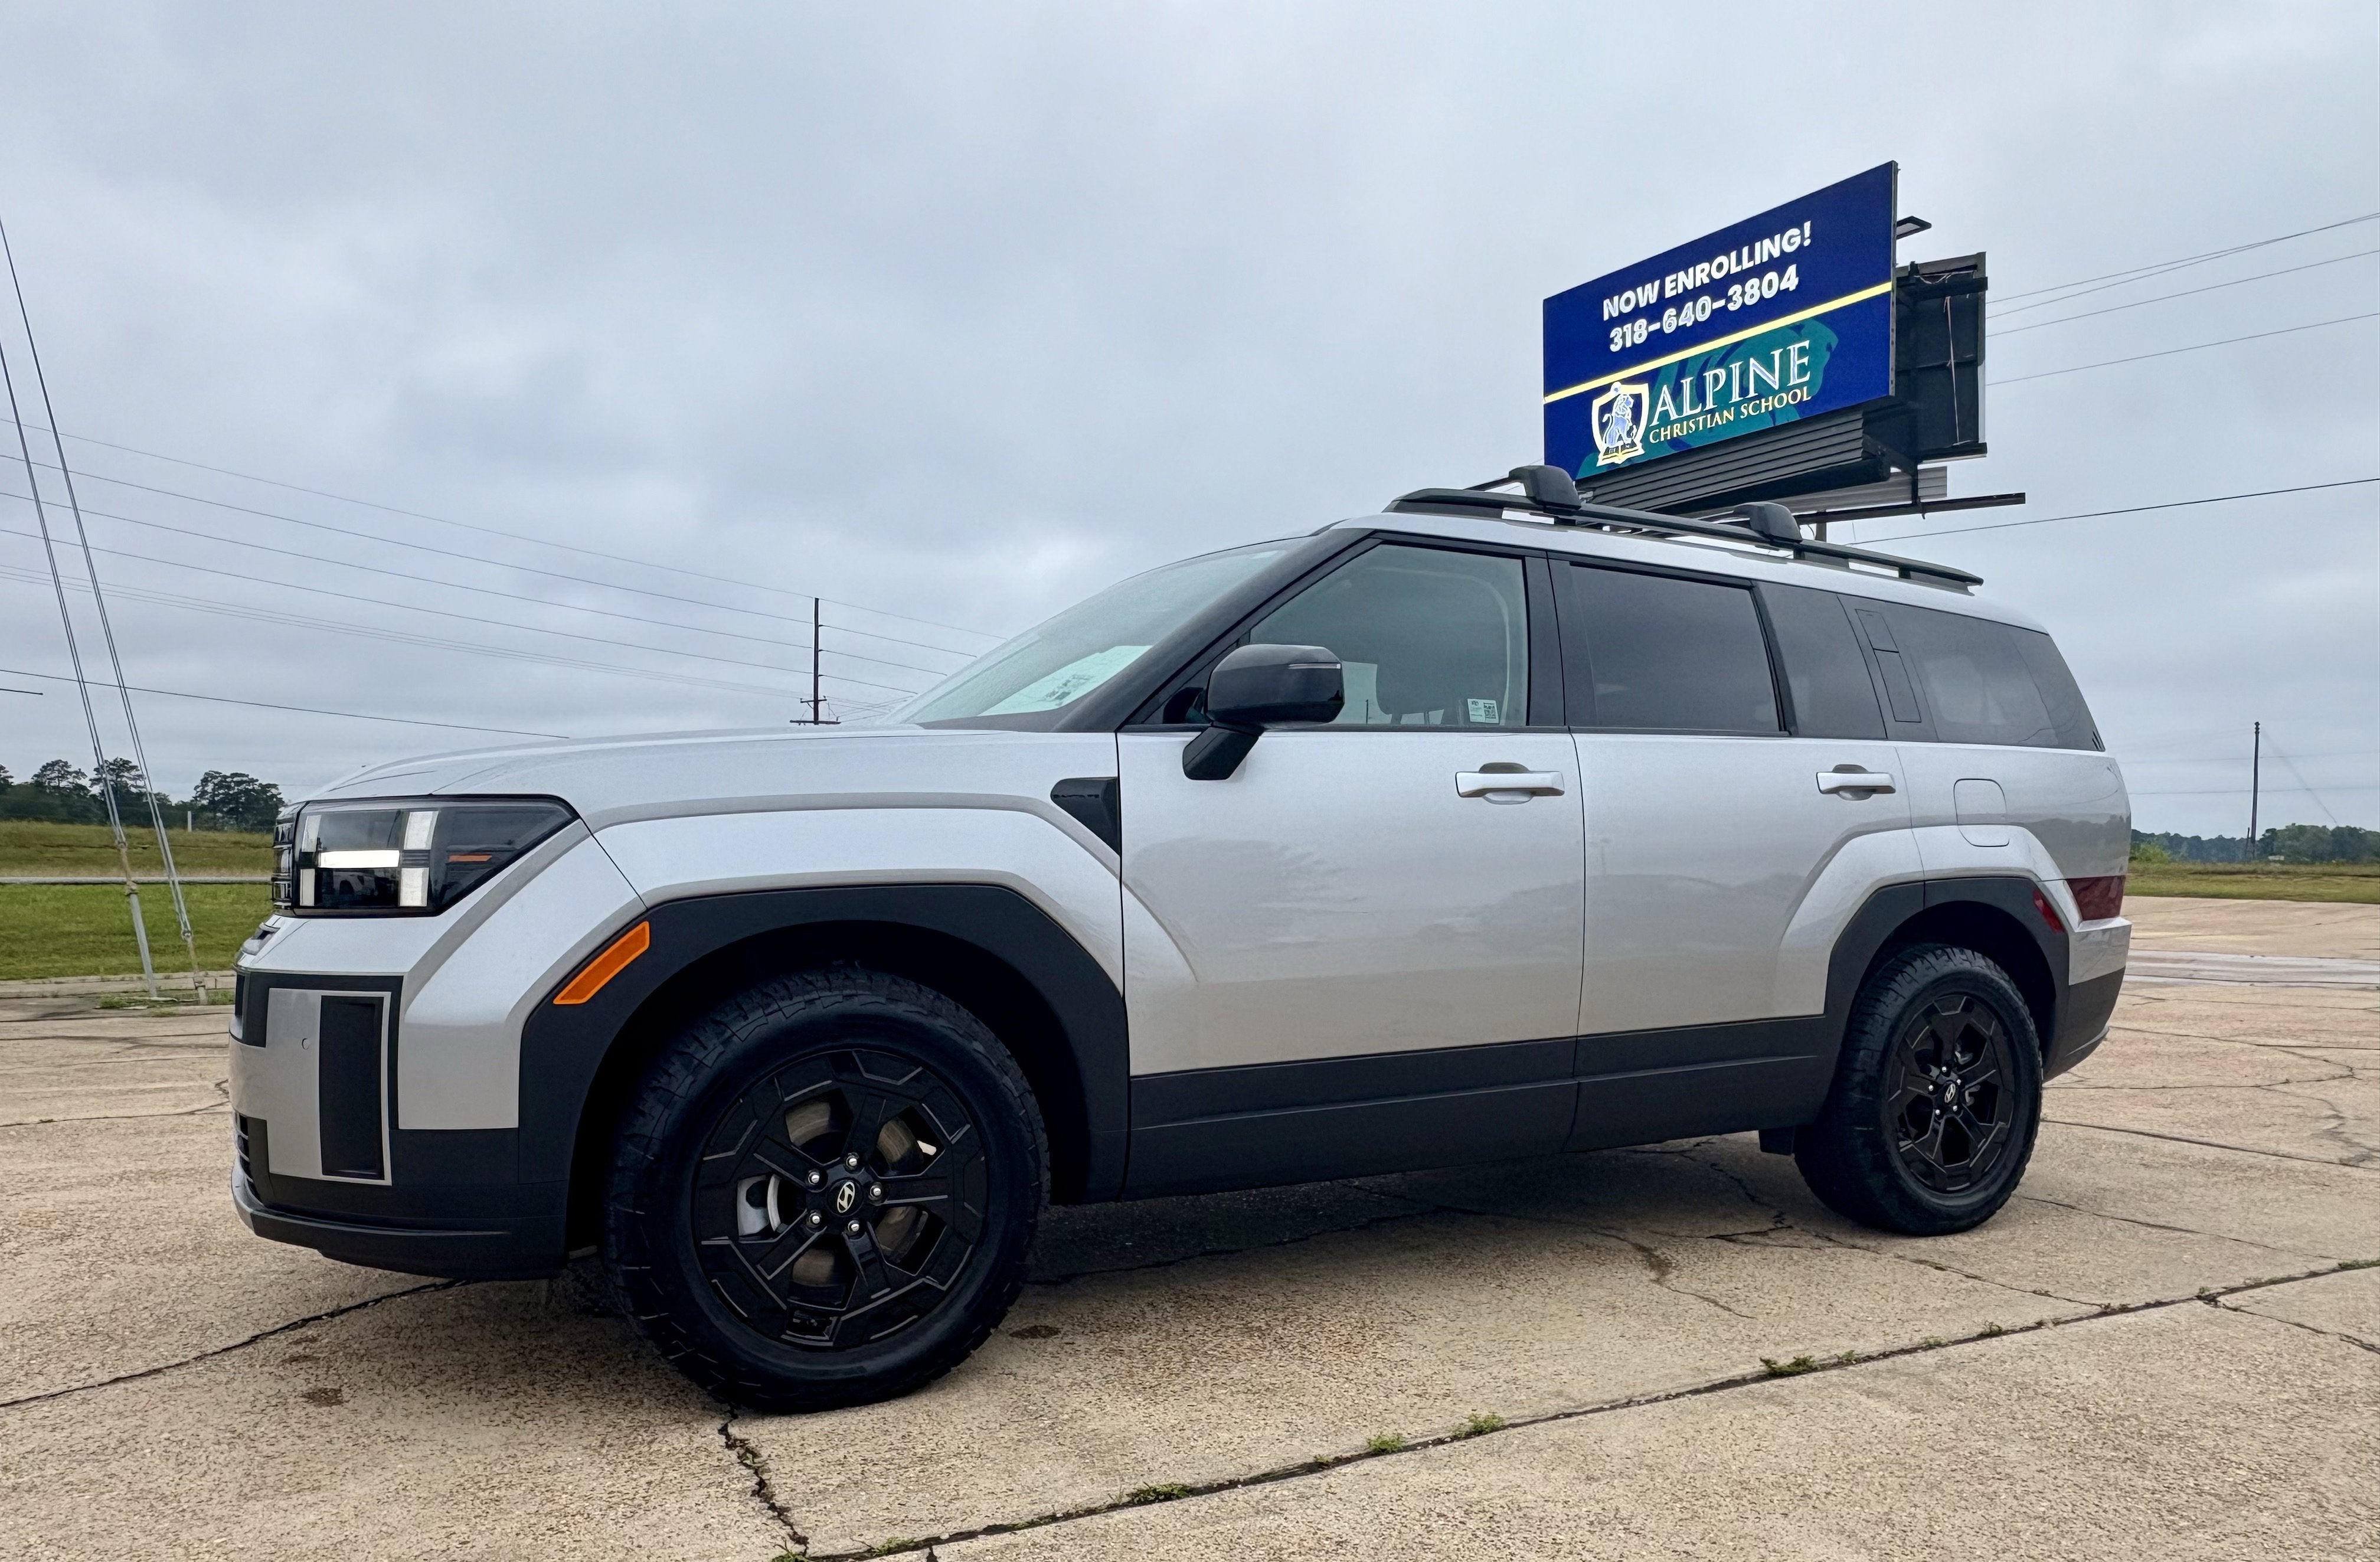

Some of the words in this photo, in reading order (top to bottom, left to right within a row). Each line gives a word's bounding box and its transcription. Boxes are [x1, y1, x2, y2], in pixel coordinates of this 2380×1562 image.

[1603, 279, 1660, 321] NOW
[1665, 220, 1812, 299] ENROLLING!
[1609, 264, 1799, 352] 318-640-3804
[1649, 339, 1811, 427] ALPINE
[1649, 406, 1734, 444] CHRISTIAN
[1740, 385, 1812, 419] SCHOOL
